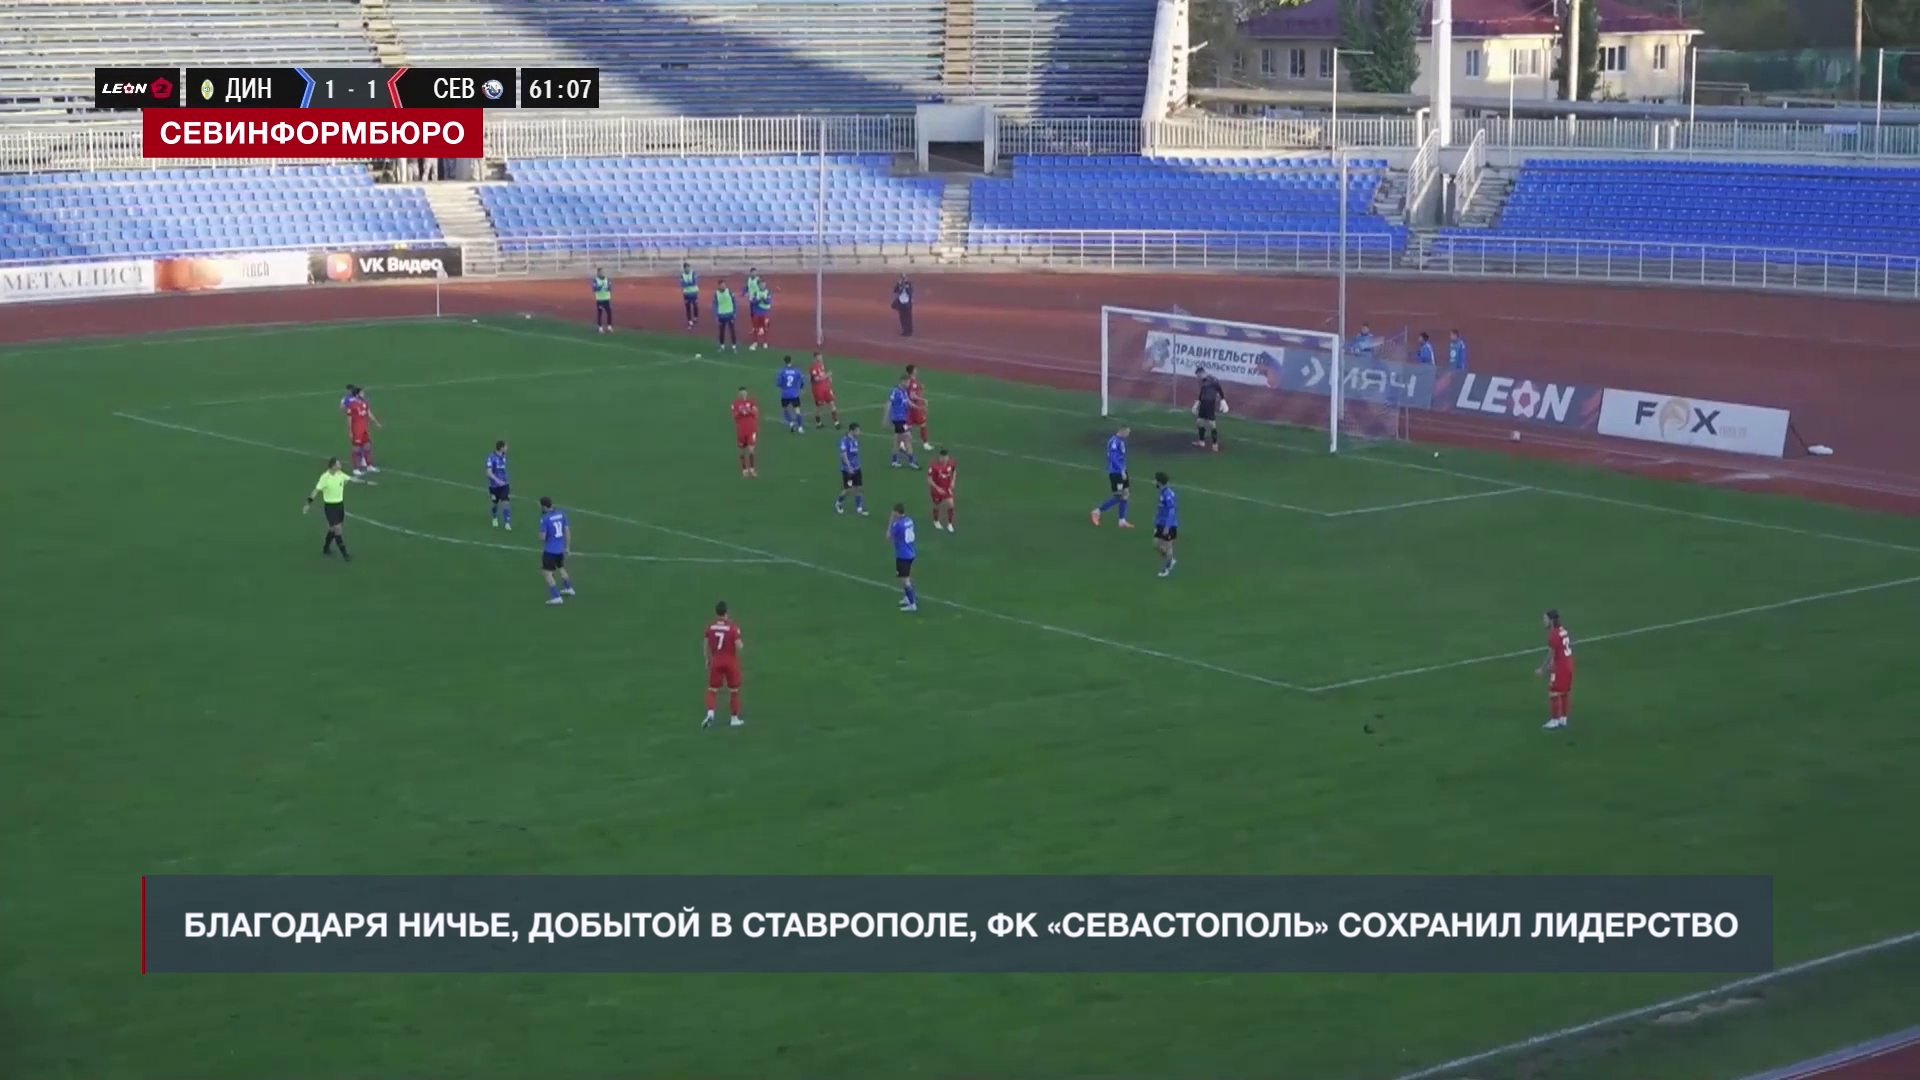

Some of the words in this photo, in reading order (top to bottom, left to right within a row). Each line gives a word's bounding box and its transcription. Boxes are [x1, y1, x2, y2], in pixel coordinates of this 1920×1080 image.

[359, 257, 384, 273] VK
[387, 256, 443, 274] Видео
[1456, 373, 1575, 423] LEON
[714, 631, 725, 650] 7
